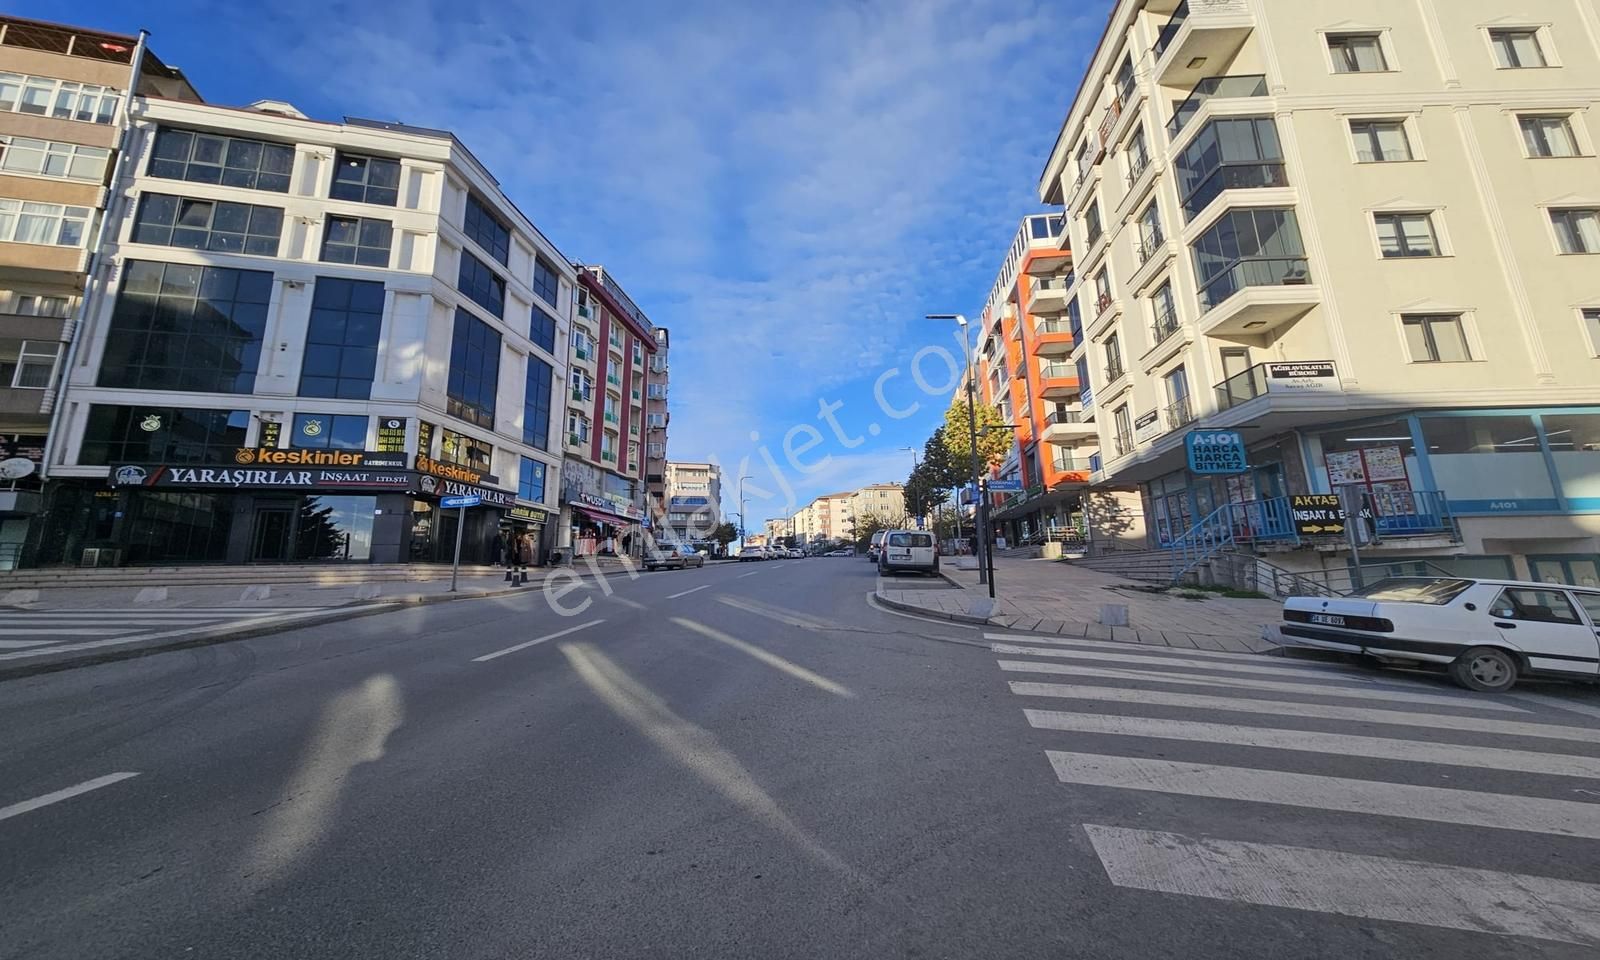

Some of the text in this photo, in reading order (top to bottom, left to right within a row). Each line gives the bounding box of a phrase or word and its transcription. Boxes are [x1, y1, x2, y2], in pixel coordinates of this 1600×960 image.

[1193, 444, 1240, 454] HARCA
[258, 448, 363, 466] keskinler
[1194, 453, 1241, 463] HARCA
[169, 468, 313, 487] YARAŞIRLAR
[319, 470, 369, 483] İNŞAAT
[429, 460, 481, 484] keskinler
[1294, 495, 1338, 506] AKTAŞ
[1293, 508, 1326, 521] İNŞAAT
[1328, 510, 1335, 519] &
